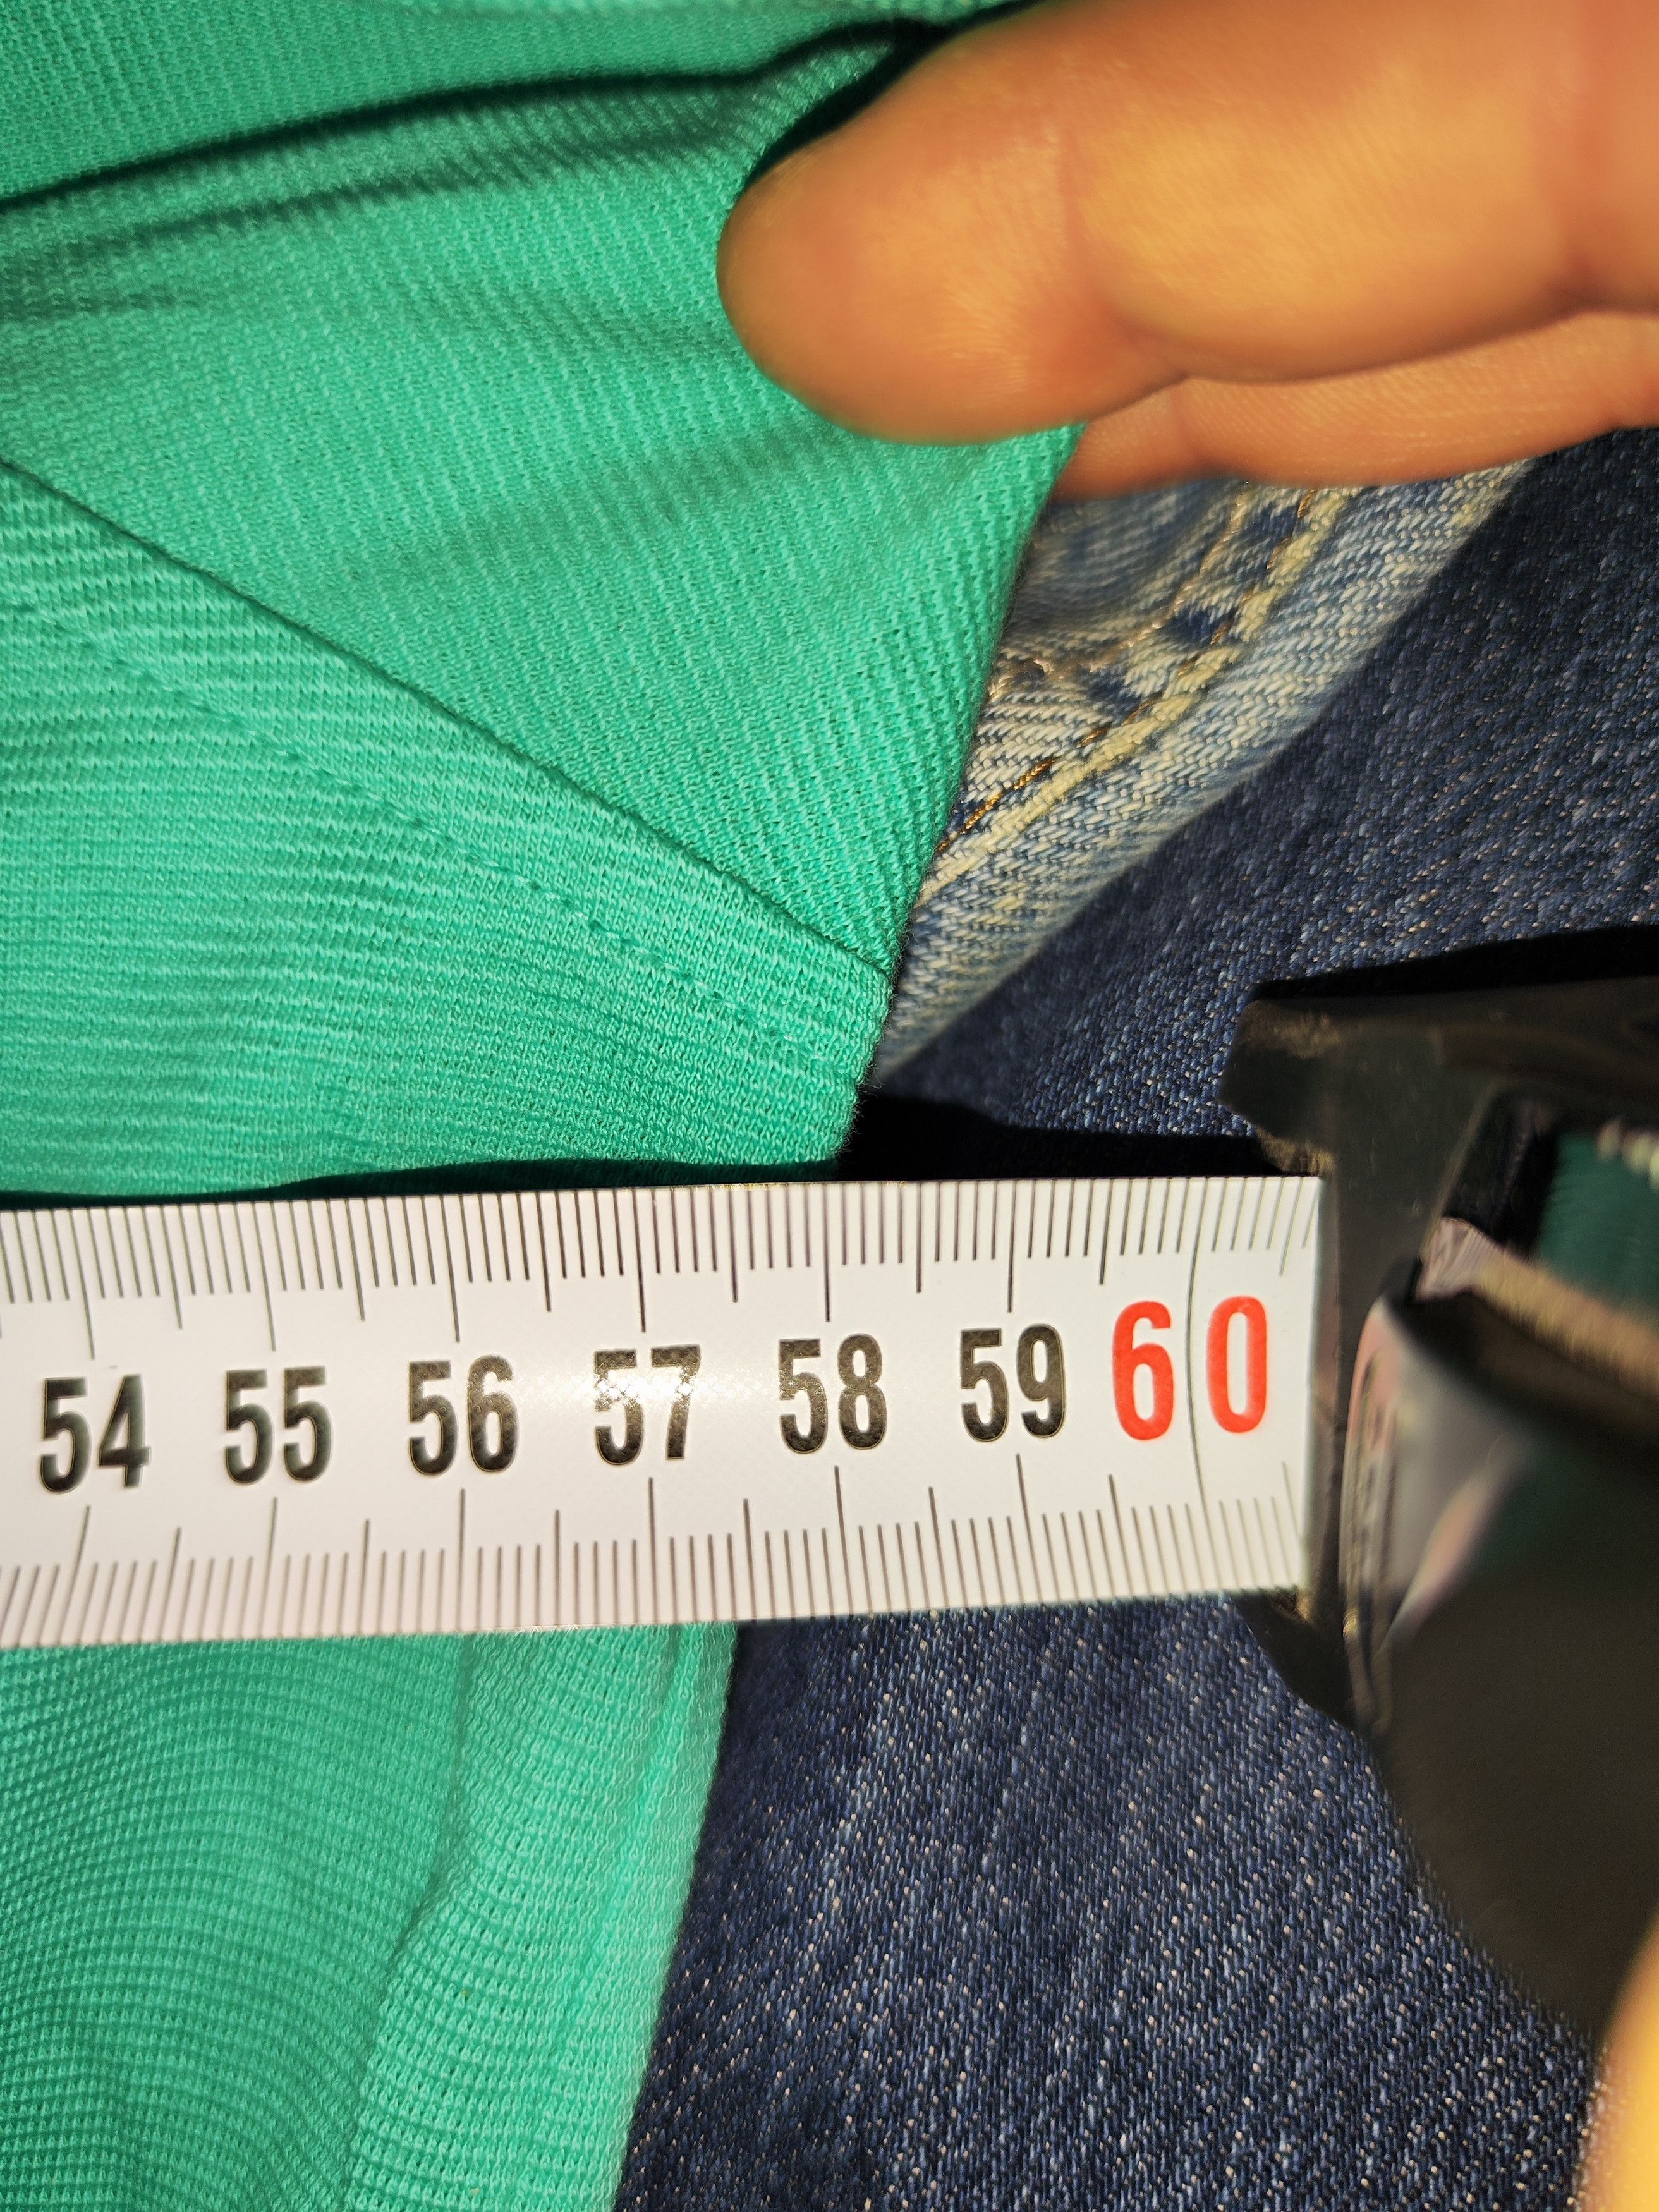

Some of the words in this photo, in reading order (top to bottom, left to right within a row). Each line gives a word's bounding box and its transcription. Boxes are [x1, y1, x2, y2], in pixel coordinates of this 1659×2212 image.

[39, 1373, 151, 1493] 54
[224, 1366, 332, 1484] 55
[408, 1354, 519, 1476] 56
[593, 1344, 702, 1466] 57
[778, 1333, 887, 1454] 58
[959, 1323, 1066, 1442] 59
[1111, 1296, 1268, 1441] 60
